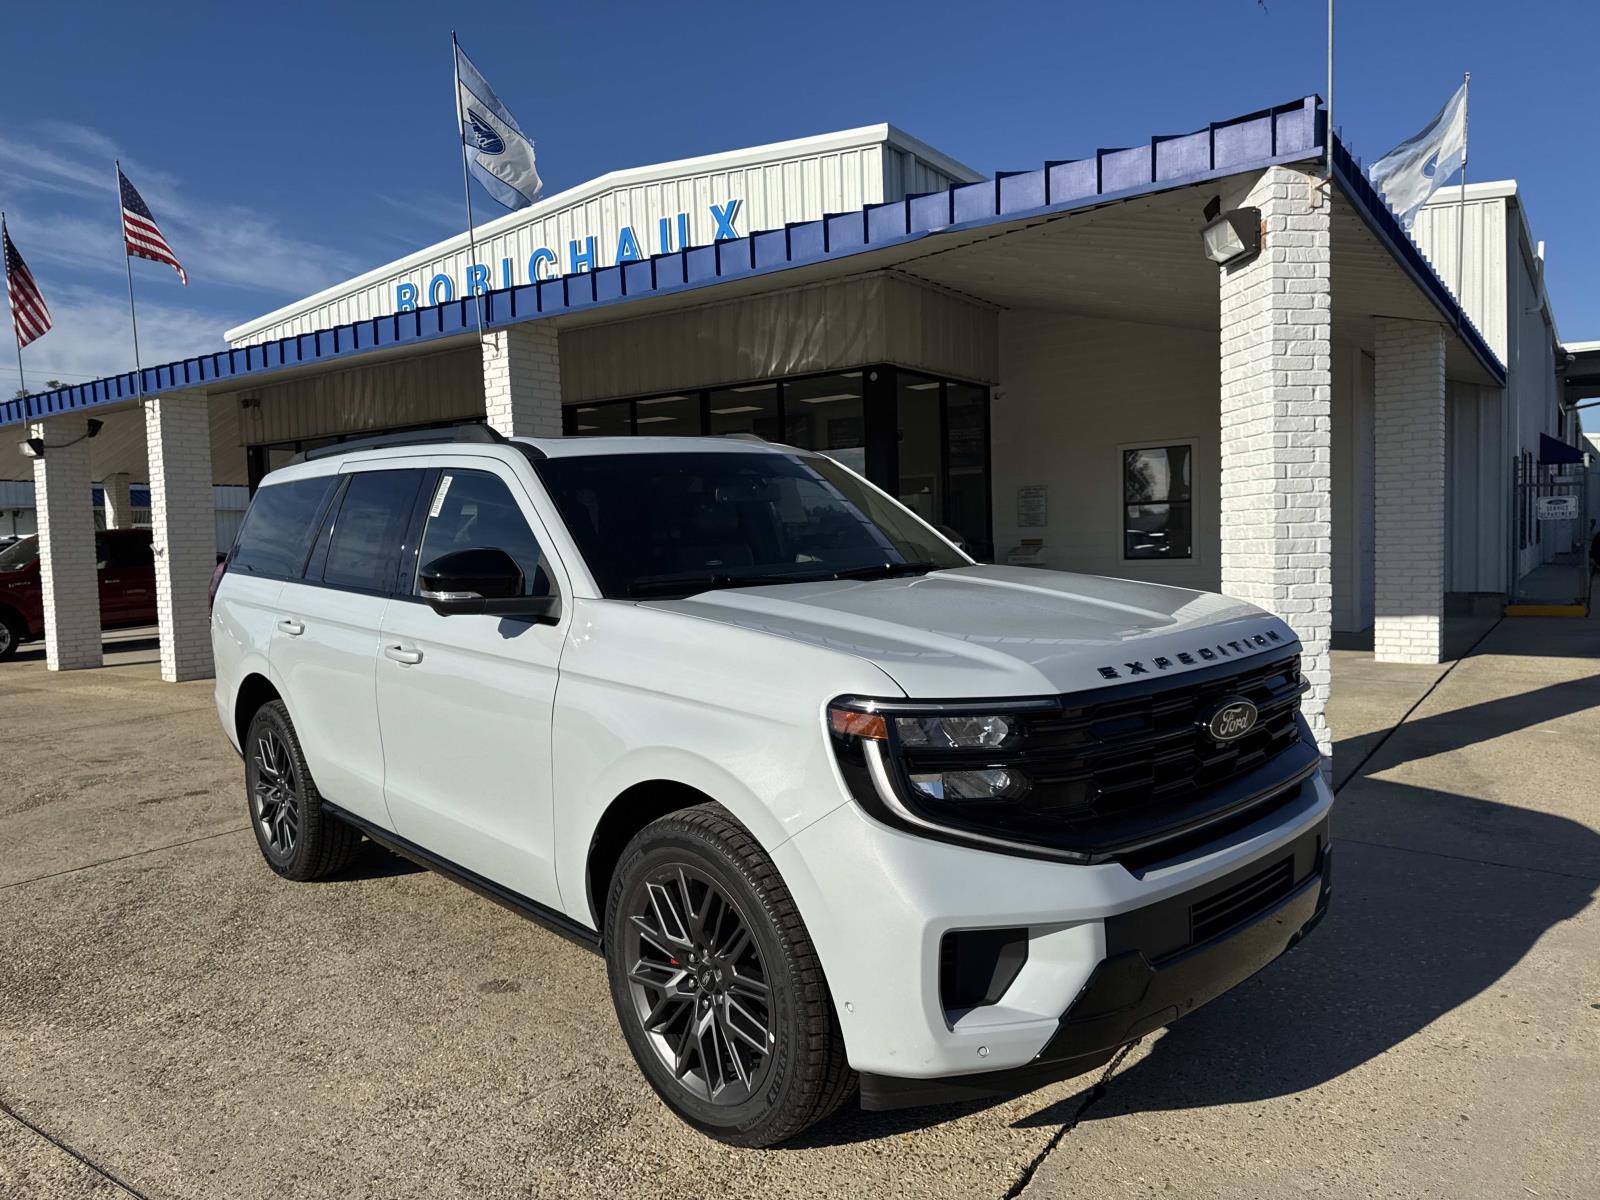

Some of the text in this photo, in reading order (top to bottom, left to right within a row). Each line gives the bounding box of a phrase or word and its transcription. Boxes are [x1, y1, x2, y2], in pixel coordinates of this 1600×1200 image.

[396, 199, 739, 312] ROBICHAUX
[1097, 630, 1281, 680] EXPEDITION
[1219, 706, 1249, 736] Ford
